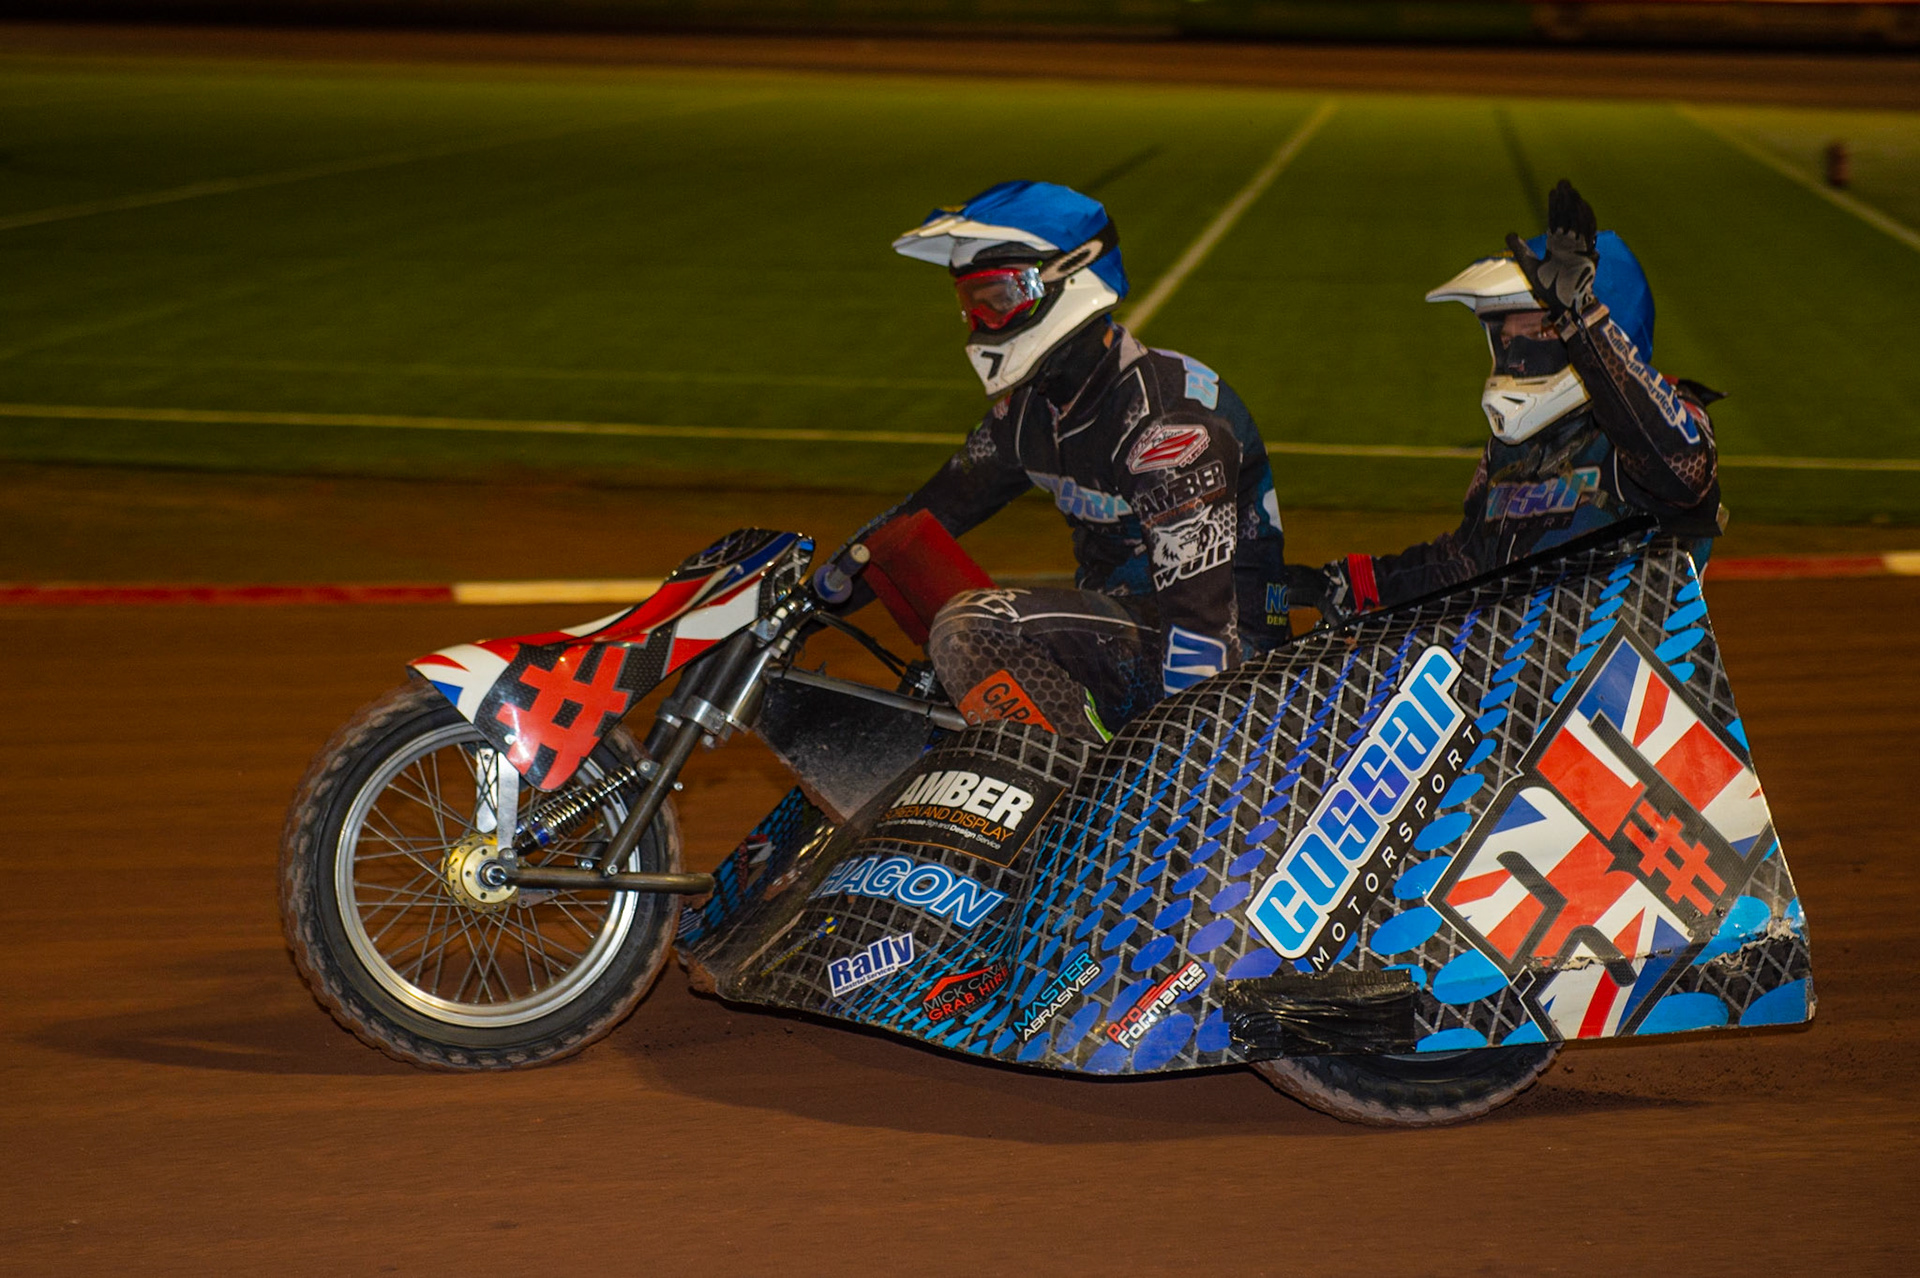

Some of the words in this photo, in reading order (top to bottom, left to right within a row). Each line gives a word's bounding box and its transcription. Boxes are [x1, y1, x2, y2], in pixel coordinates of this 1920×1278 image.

[890, 770, 1035, 831] AMBER
[921, 806, 950, 820] AND
[950, 810, 1015, 842] DISPLAY
[949, 824, 977, 840] Design
[976, 834, 1002, 850] Service
[1311, 726, 1479, 971] MOTORSPORT
[827, 935, 914, 989] Rally
[866, 965, 896, 981] Services
[923, 984, 965, 1013] MICK
[928, 992, 976, 1021] GRAB
[978, 966, 1010, 996] HIRE
[1013, 952, 1094, 1033] MASTER
[1023, 963, 1101, 1042] ABRASIVES
[1106, 1006, 1143, 1043] Pro
